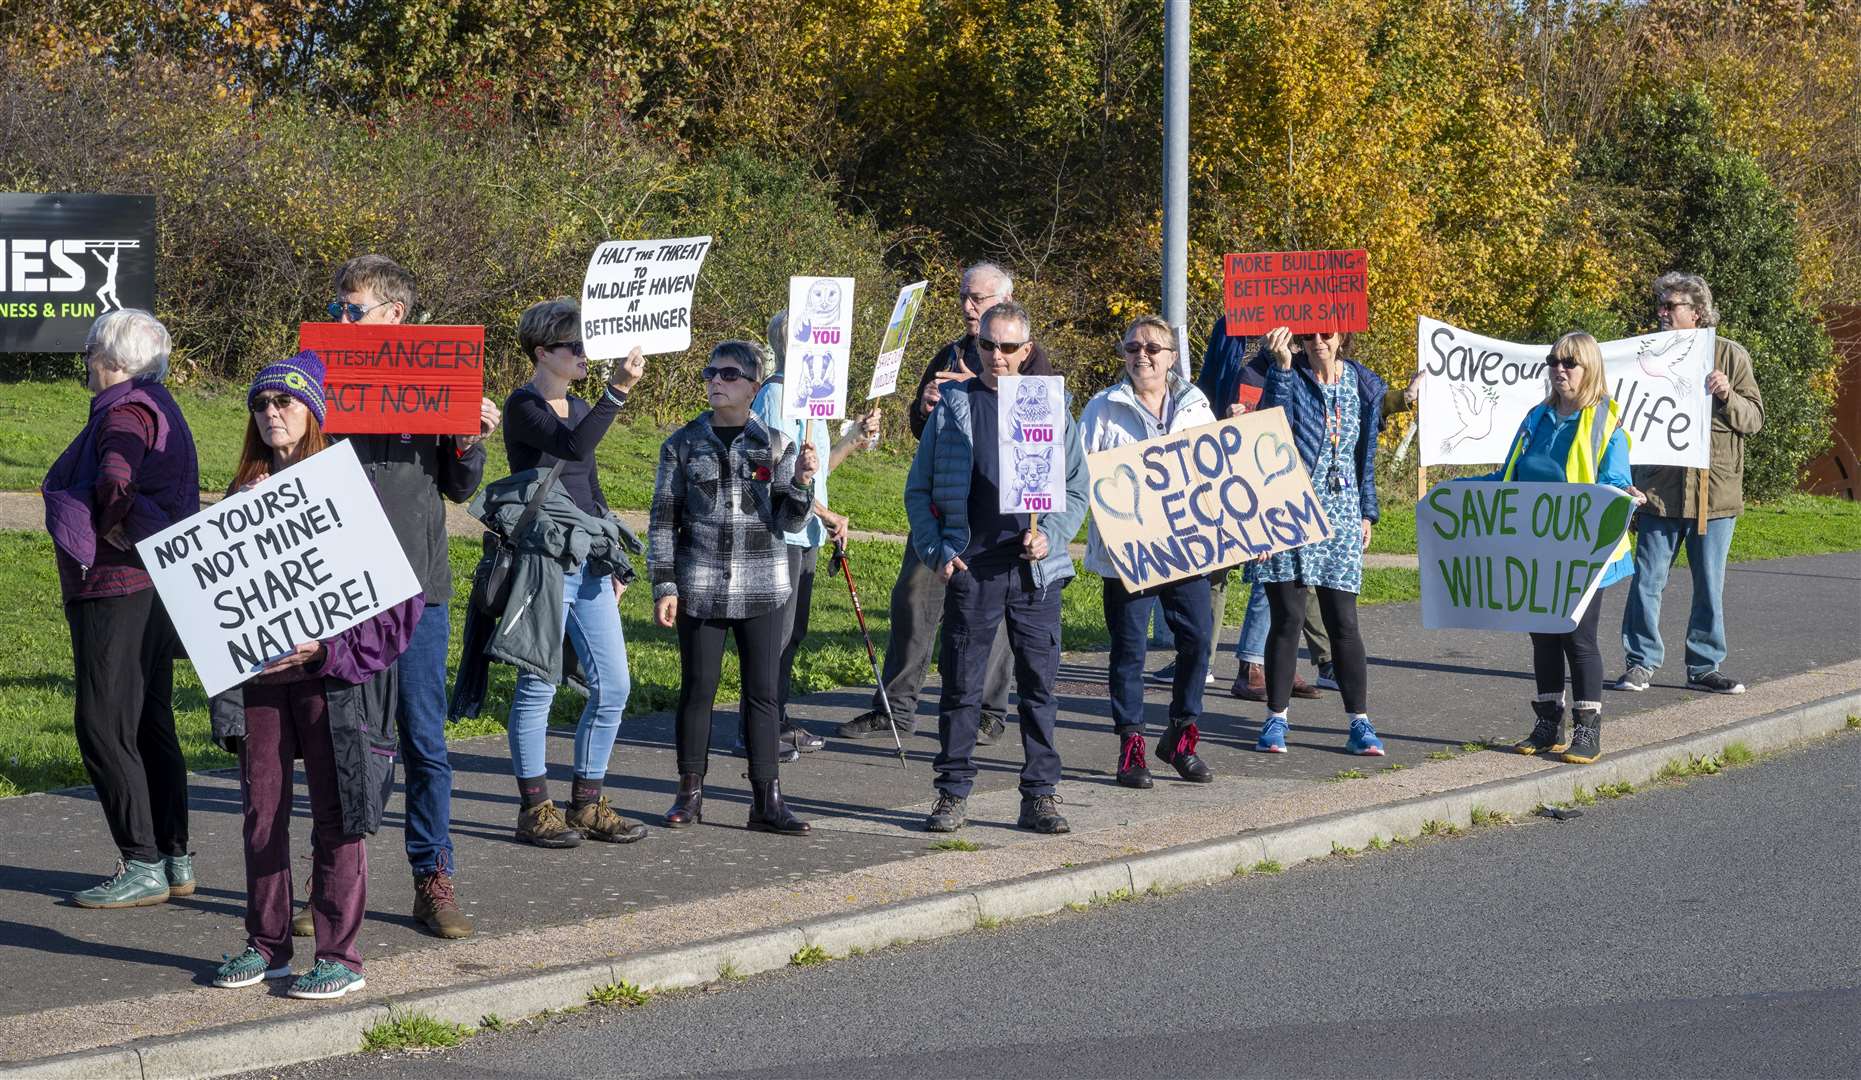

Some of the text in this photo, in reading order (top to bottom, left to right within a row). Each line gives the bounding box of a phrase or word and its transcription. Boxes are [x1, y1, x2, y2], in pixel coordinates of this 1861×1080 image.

[597, 241, 709, 265] HALT THE THREAT
[1232, 256, 1273, 275] MORE
[1282, 253, 1355, 273] BUILDING
[634, 266, 648, 279] TO
[1234, 273, 1364, 297] BETTESHANGER!
[587, 273, 695, 300] WILDLIFE HAVEN
[43, 303, 56, 318] &
[62, 303, 95, 318] FUN
[627, 299, 641, 313] AT
[1227, 303, 1355, 323] HAVE YOUR SAY!
[585, 307, 688, 340] BETTESHANGER
[812, 331, 841, 344] YOU
[1426, 327, 1549, 386] Save our
[325, 384, 450, 414] ACT NOW!
[809, 404, 835, 417] YOU
[1023, 428, 1053, 442] YOU
[1142, 425, 1242, 491] STOP
[1023, 497, 1052, 510] YOU
[1161, 475, 1258, 537] ECO
[1429, 488, 1592, 543] SAVE OUR
[154, 477, 309, 569] NOT YOURS!
[191, 498, 343, 590] NOT MINE!
[1107, 491, 1329, 586] VANDALISM
[214, 546, 333, 629] SHARE
[226, 570, 380, 674] NATURE!
